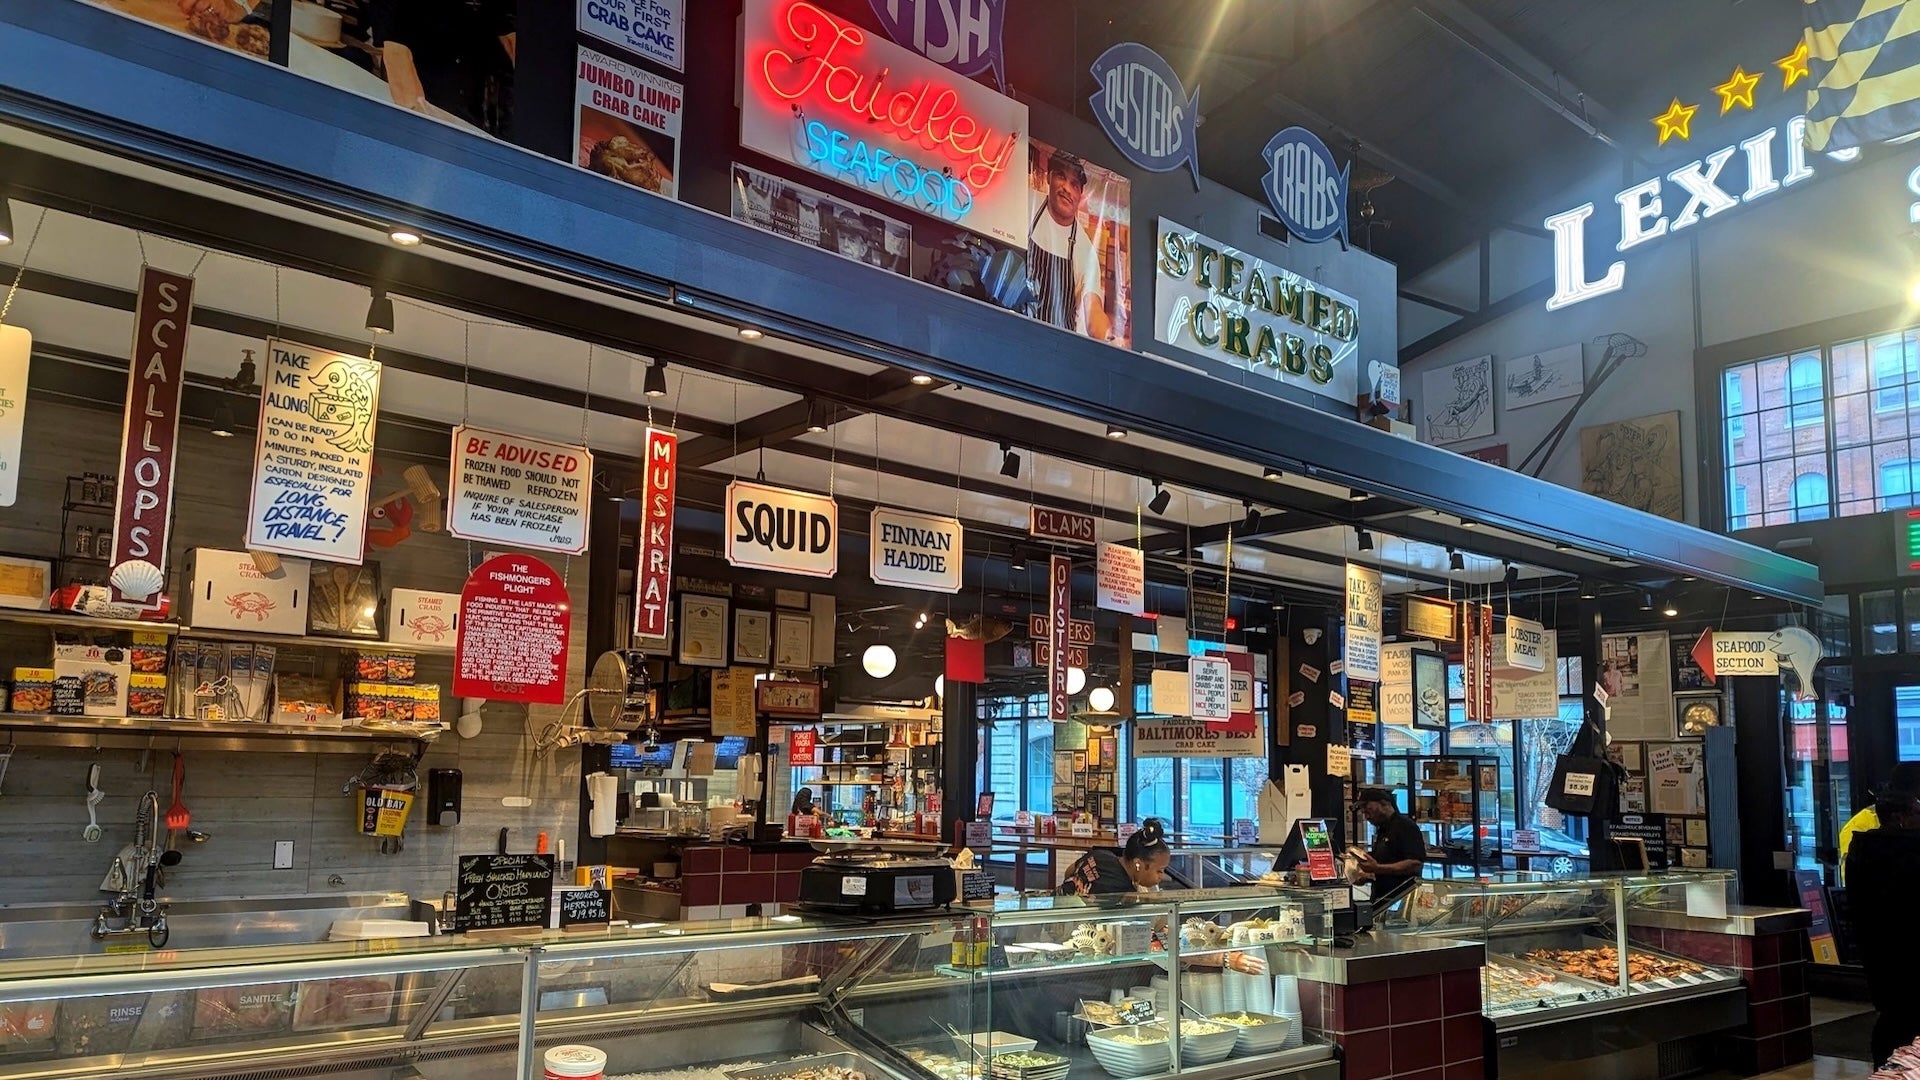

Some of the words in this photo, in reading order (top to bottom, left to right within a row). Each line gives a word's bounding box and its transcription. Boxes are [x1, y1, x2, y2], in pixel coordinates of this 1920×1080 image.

[634, 8, 671, 31] FIRST
[651, 2, 671, 19] FOR
[587, 1, 629, 32] CRAB
[633, 22, 675, 52] CAKE
[580, 48, 626, 73] AWARD
[629, 67, 682, 94] WINNING
[578, 61, 635, 98] JUMBO
[638, 83, 681, 115] LUMP
[592, 90, 630, 116] CRAB
[632, 105, 666, 130] CAKE
[1104, 62, 1184, 158] OYSTERS
[806, 120, 972, 215] SEAFOOD
[1272, 141, 1340, 231] CRABS
[1158, 231, 1360, 343] STEAMED
[1189, 300, 1335, 386] CRABS
[272, 349, 310, 371] TAKE
[275, 370, 302, 389] ME
[266, 392, 308, 414] ALONG
[129, 282, 179, 557] SCALLOPS
[271, 417, 292, 429] CAN
[295, 422, 307, 432] BE
[309, 424, 337, 437] READY
[268, 427, 279, 438] TO
[284, 431, 298, 441] GO
[302, 434, 314, 444] IN
[264, 440, 307, 456] MINUTES
[310, 450, 344, 463] PACKED
[348, 457, 360, 466] IN
[466, 437, 491, 457] BE
[494, 443, 578, 473] ADVISED
[264, 452, 273, 462] A
[318, 463, 363, 479] INSULATED
[265, 465, 302, 478] CARTON
[307, 472, 355, 488] DESIGNED
[464, 458, 497, 474] FROZEN
[500, 464, 522, 478] FOOD
[524, 470, 557, 485] SHOULD
[561, 477, 581, 489] NOT
[264, 476, 326, 493] ESPECIALLY
[330, 487, 352, 498] FOR
[463, 473, 475, 484] BE
[476, 474, 511, 490] THAWED
[527, 484, 578, 502] REFROZEN
[274, 490, 327, 508] LONG
[463, 490, 500, 504] INQUIRE
[502, 496, 514, 505] OF
[518, 500, 579, 516] SALESPERSON
[263, 506, 349, 528] DISTANCE
[470, 512, 491, 523] HAS
[494, 516, 518, 527] BEEN
[520, 520, 560, 534] FROZEN
[472, 502, 481, 510] IF
[487, 503, 509, 515] YOUR
[514, 509, 564, 524] PURCHASE
[644, 439, 671, 630] MUSKRAT
[736, 500, 831, 554] SQUID
[1037, 511, 1092, 539] CLAMS
[880, 522, 952, 551] FINNAN
[511, 564, 528, 573] THE
[883, 548, 947, 574] HADDIE
[489, 572, 551, 586] FISHMONGERS
[503, 584, 535, 594] PLIGHT
[1349, 578, 1367, 594] TAKE
[418, 597, 443, 605] STEAMED
[418, 604, 442, 612] CRABS
[1349, 594, 1360, 610] ME
[1056, 564, 1067, 715] OYSTERS
[1510, 626, 1542, 645] LOBSTER
[1514, 642, 1538, 657] MEAT
[1716, 640, 1766, 655] SEAFOOD
[1716, 656, 1765, 669] SECTION
[1468, 640, 1476, 718] SHELL
[366, 797, 384, 807] OLD
[386, 799, 404, 809] BAY
[485, 882, 529, 900] OYSTERS
[566, 891, 600, 901] SMOKED
[564, 899, 603, 911] HERRING
[569, 910, 597, 919] $19.95
[239, 993, 283, 1005] SANITIZE
[110, 1006, 142, 1019] RINSE
